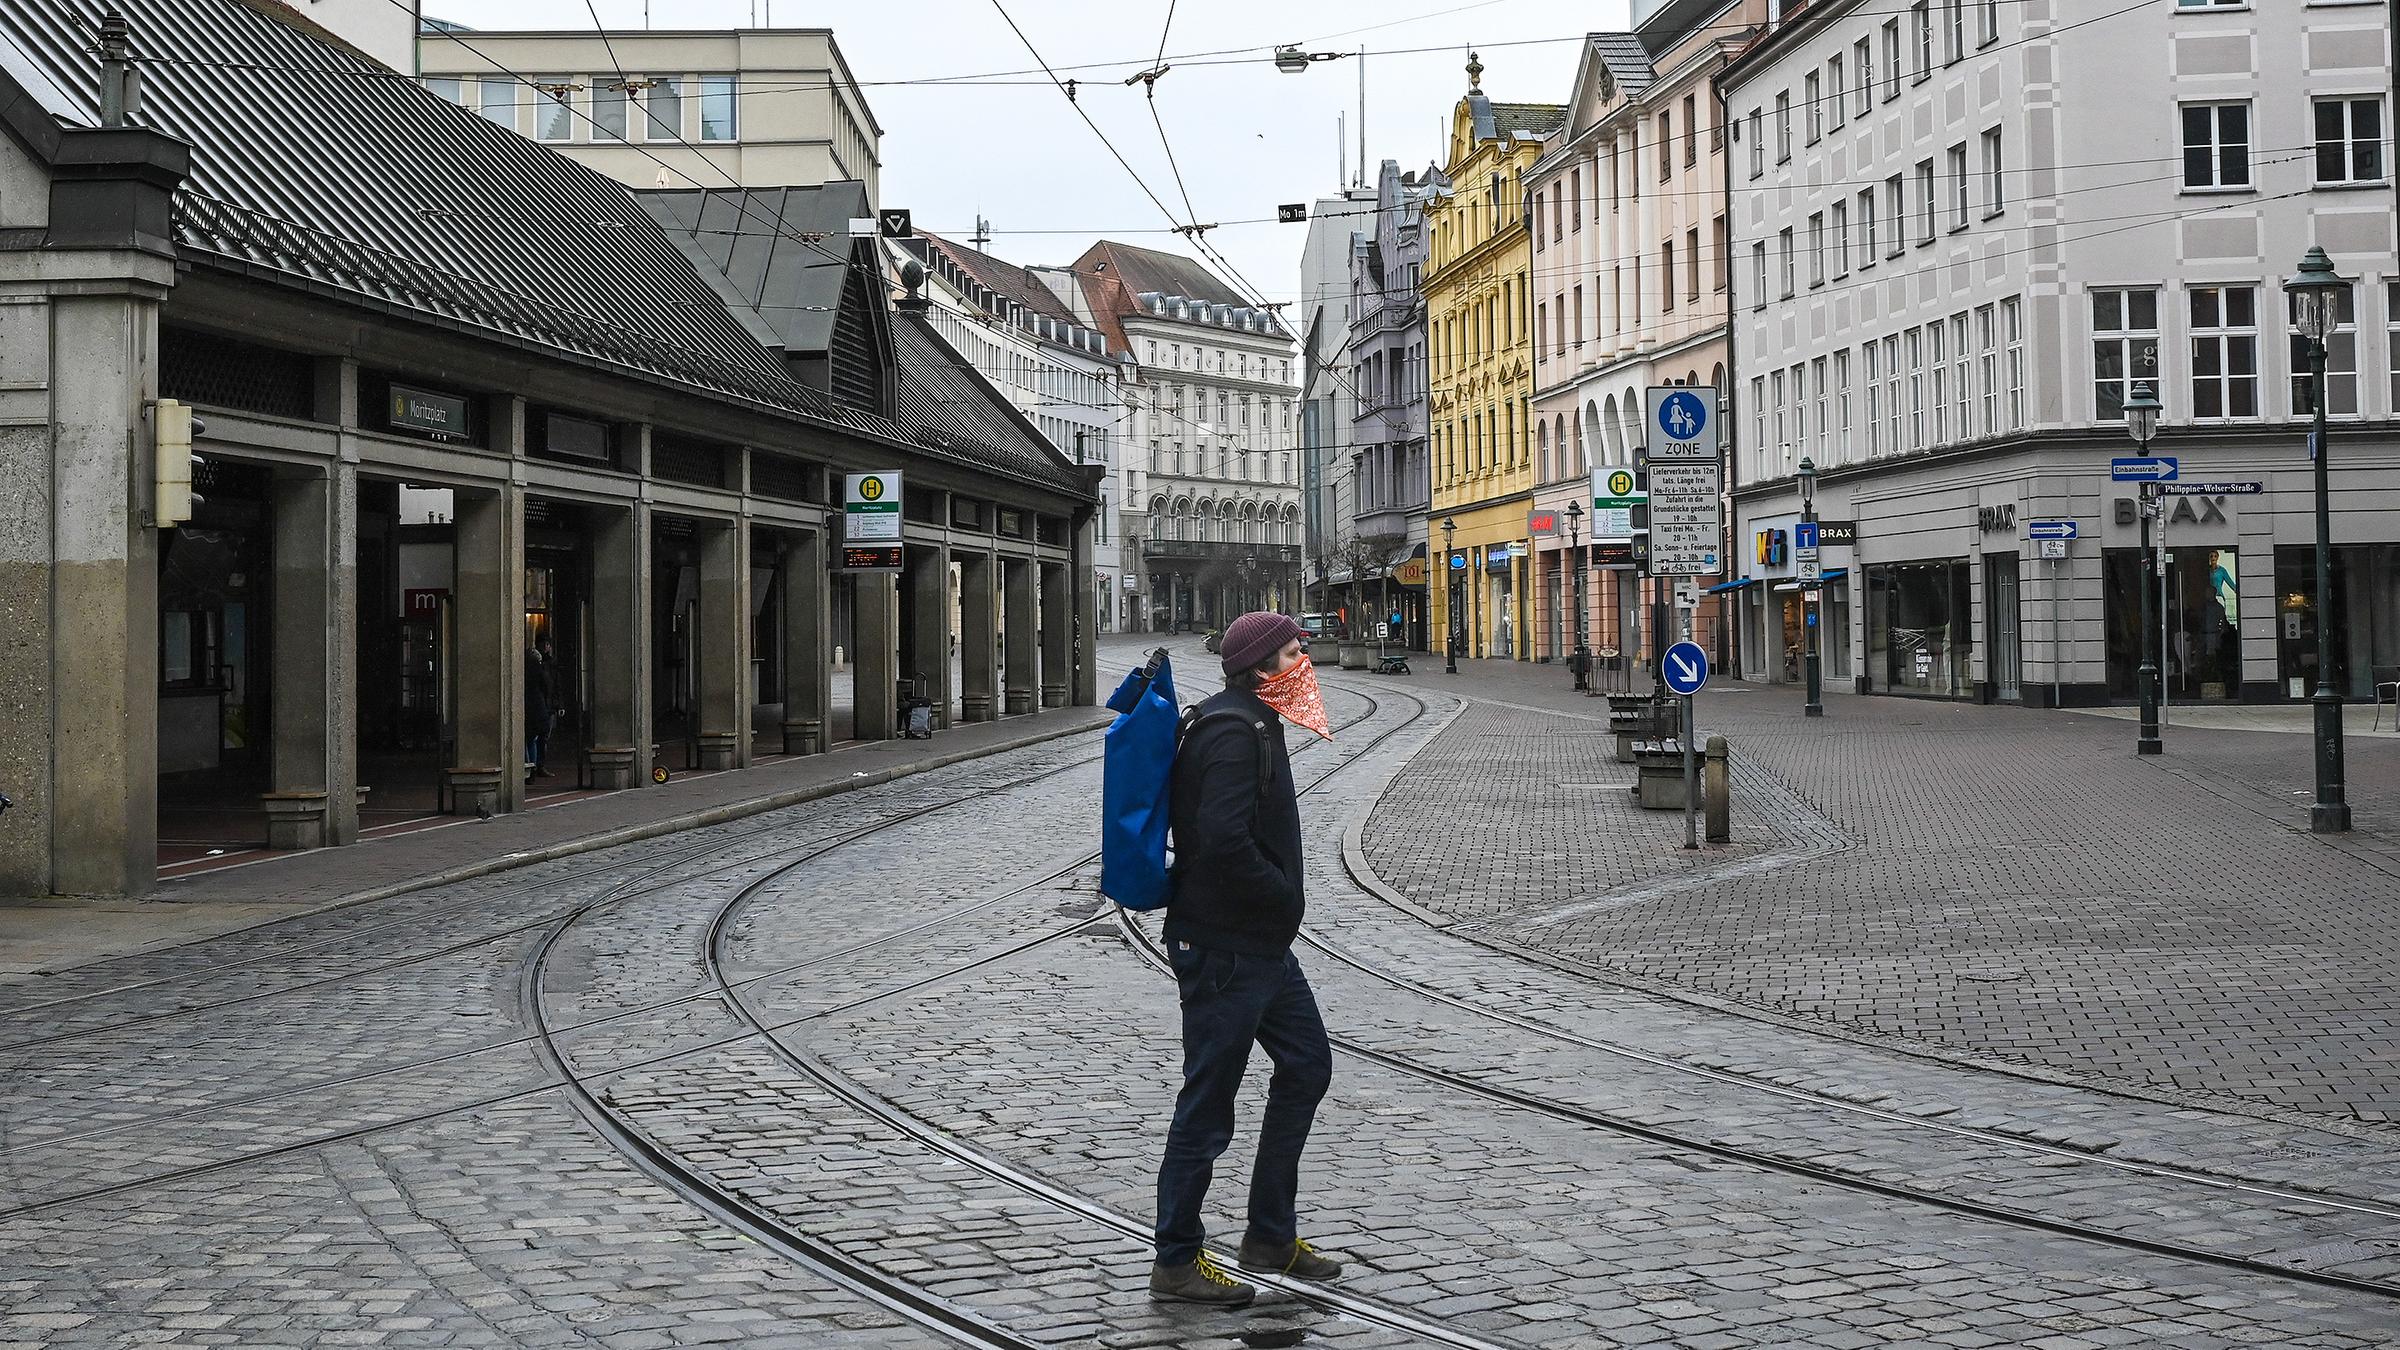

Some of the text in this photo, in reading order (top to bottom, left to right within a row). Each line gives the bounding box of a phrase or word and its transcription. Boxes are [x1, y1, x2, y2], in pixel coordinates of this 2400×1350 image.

[1280, 208, 1305, 219] Mo 1m
[410, 399, 446, 425] Moritzplatz
[1665, 442, 1700, 455] ZONE
[1653, 467, 1715, 475] Lieferverkehr bis 12m
[2114, 466, 2159, 474] Einbahnstraße
[1677, 476, 1694, 486] Länge
[1695, 476, 1706, 484] frei
[2165, 483, 2255, 495] Philippine-Welser-Straße
[1690, 505, 1717, 513] gestattet
[2114, 495, 2226, 525] BAX
[1819, 528, 1852, 538] BRAX
[1690, 543, 1717, 552] Feiertage
[1673, 553, 1681, 561] 20
[1688, 553, 1698, 561] 10h
[1378, 624, 1387, 636] E
